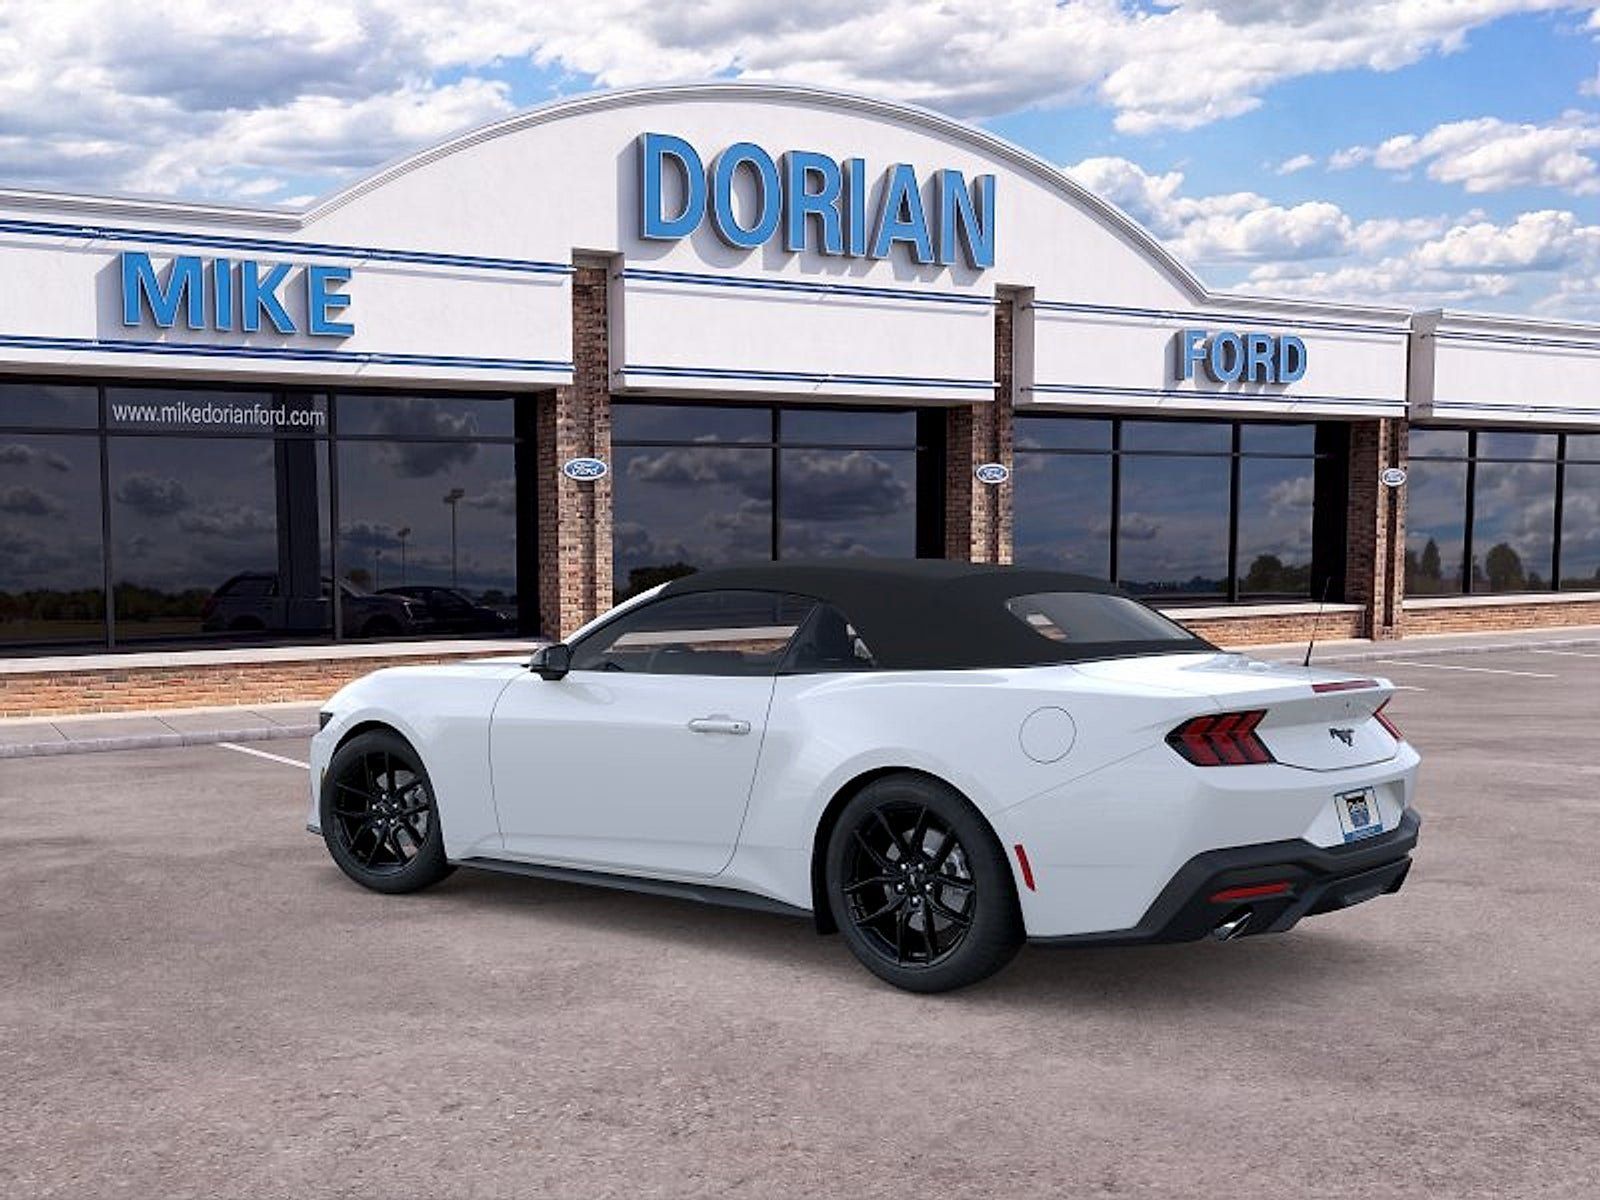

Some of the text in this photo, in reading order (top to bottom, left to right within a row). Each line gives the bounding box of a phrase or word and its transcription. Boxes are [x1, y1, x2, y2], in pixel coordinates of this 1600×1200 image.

[639, 132, 996, 269] DORIAN
[120, 251, 355, 337] MIKE
[1177, 329, 1308, 384] FORD
[112, 402, 325, 425] www.mikedorianford.com
